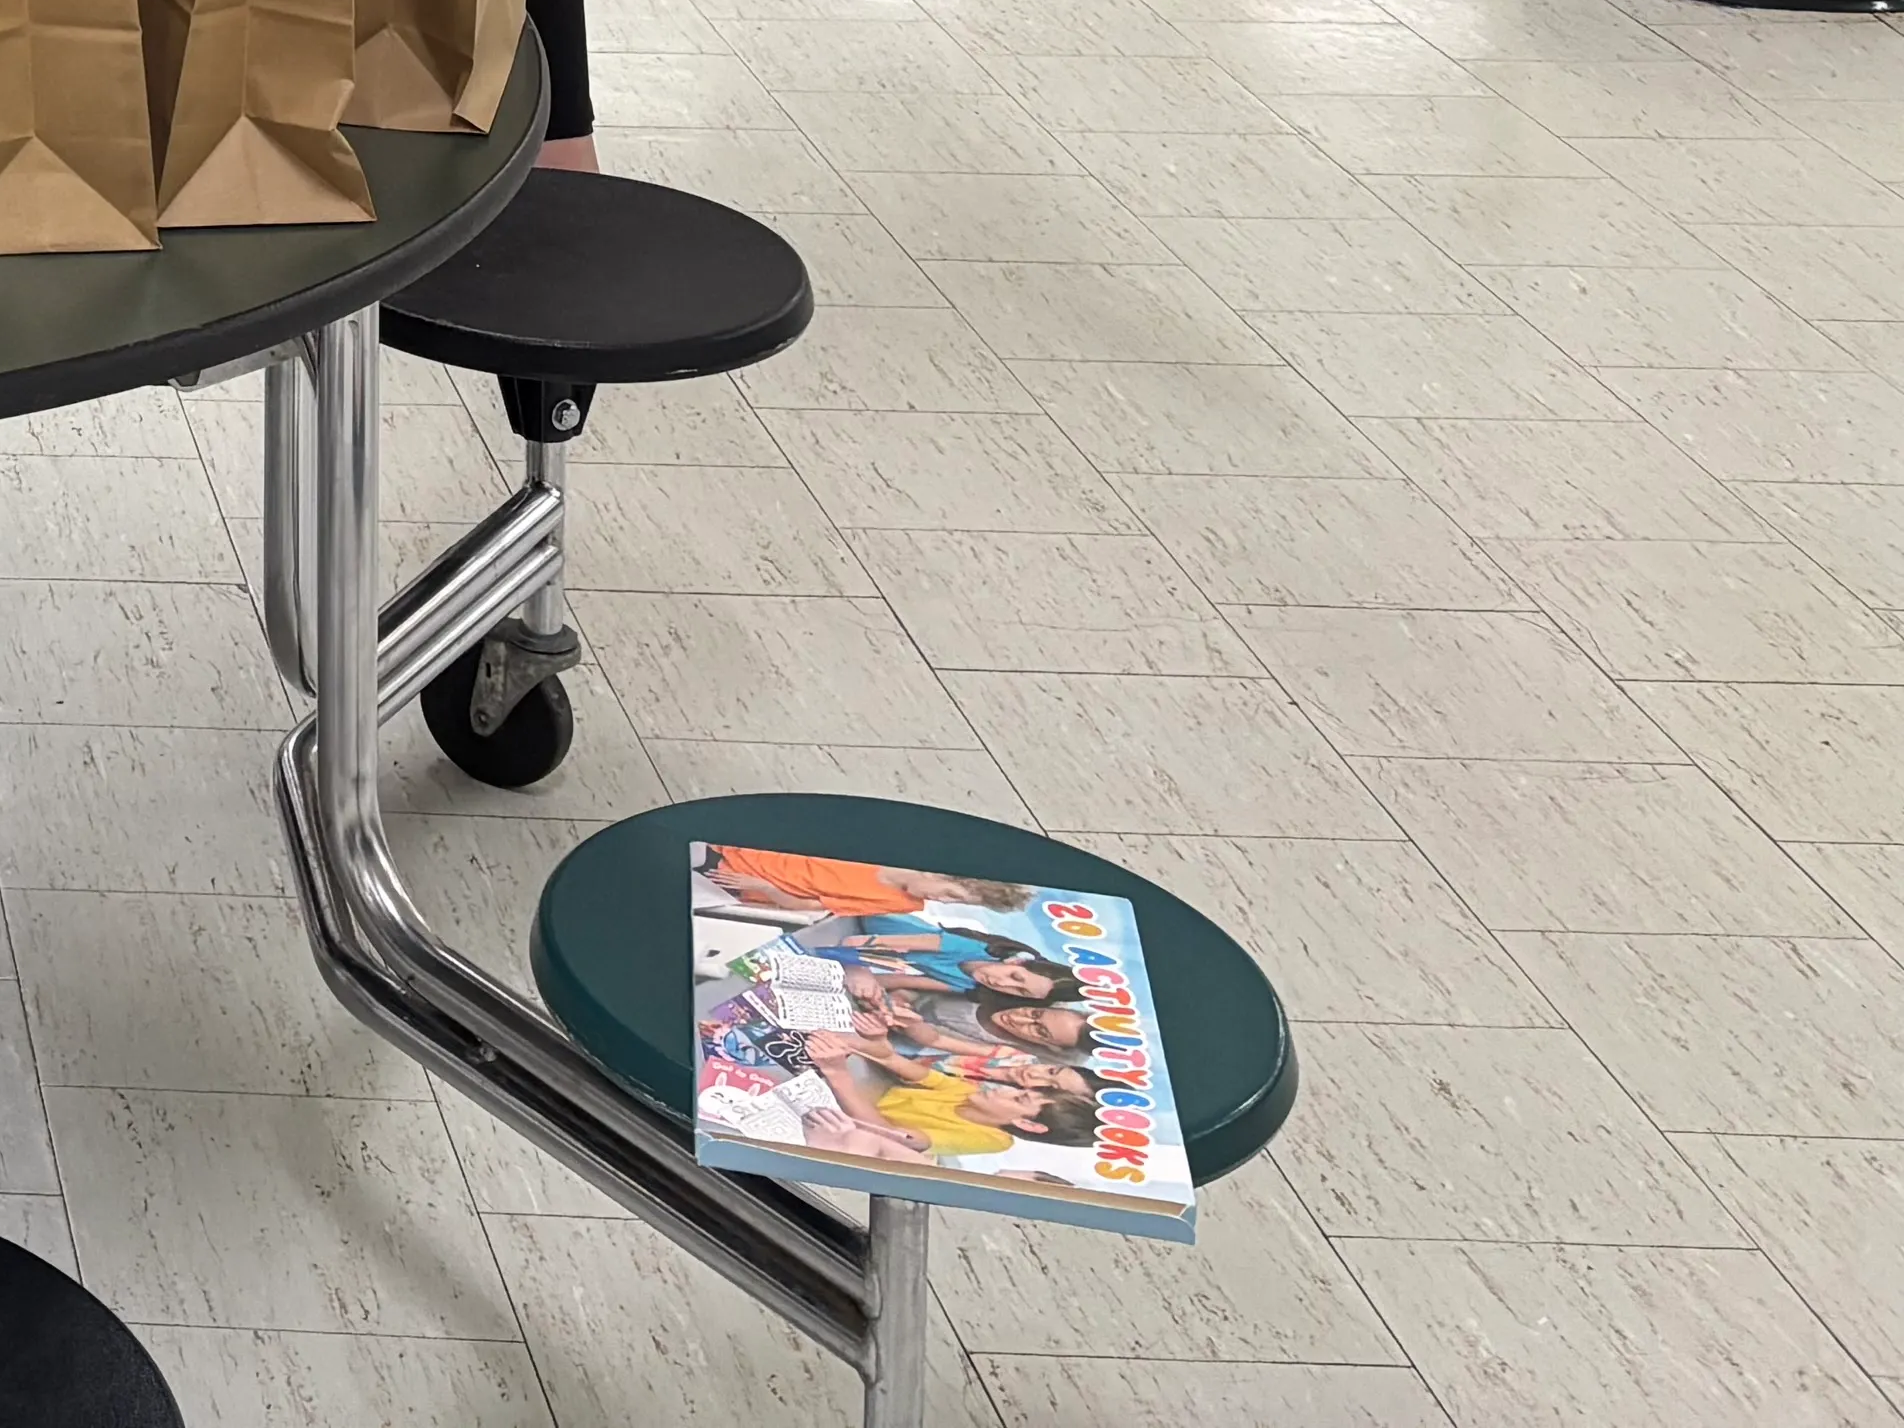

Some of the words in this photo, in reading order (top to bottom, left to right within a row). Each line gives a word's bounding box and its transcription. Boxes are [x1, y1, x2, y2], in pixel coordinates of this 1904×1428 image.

[1045, 902, 1104, 937] 20
[1065, 945, 1151, 1089] ACTIVITY
[1094, 1090, 1154, 1184] BOOKS
